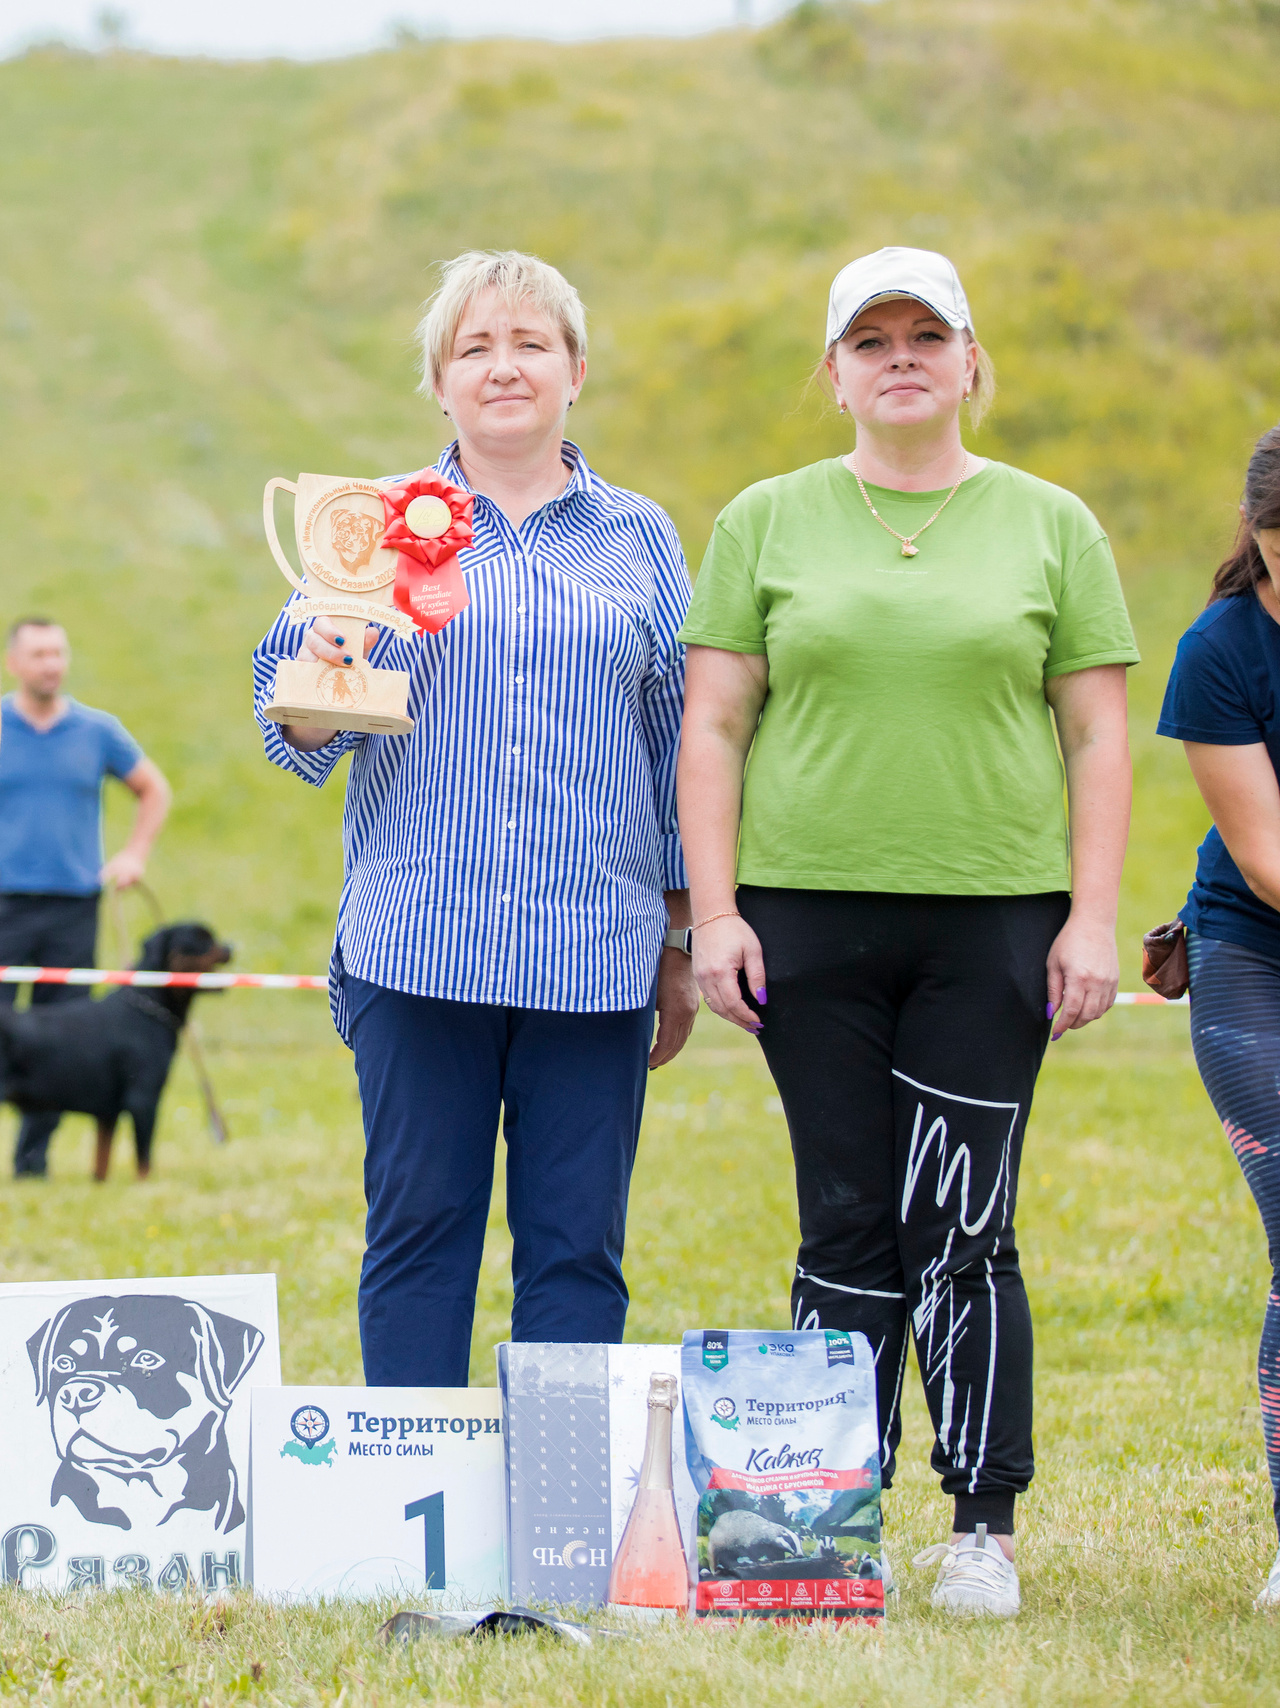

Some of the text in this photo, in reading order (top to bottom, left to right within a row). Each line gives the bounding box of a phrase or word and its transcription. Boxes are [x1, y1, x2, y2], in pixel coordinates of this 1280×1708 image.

[303, 483, 351, 543] Межрегиональный
[340, 577, 375, 589] Рязани
[375, 567, 397, 585] 2023
[421, 584, 441, 592] Best
[411, 590, 452, 603] intermediate
[427, 600, 450, 610] кубок
[305, 601, 401, 625] Победитель Класса
[706, 1341, 724, 1350] 80%
[770, 1343, 795, 1352] ЭКО
[828, 1338, 850, 1346] 100%
[347, 1411, 501, 1440] Территори
[745, 1443, 824, 1472] Кавказ
[745, 1482, 778, 1492] ИНДЕЙКА
[784, 1479, 825, 1489] БРУСНИКОЙ
[404, 1490, 446, 1590] 1
